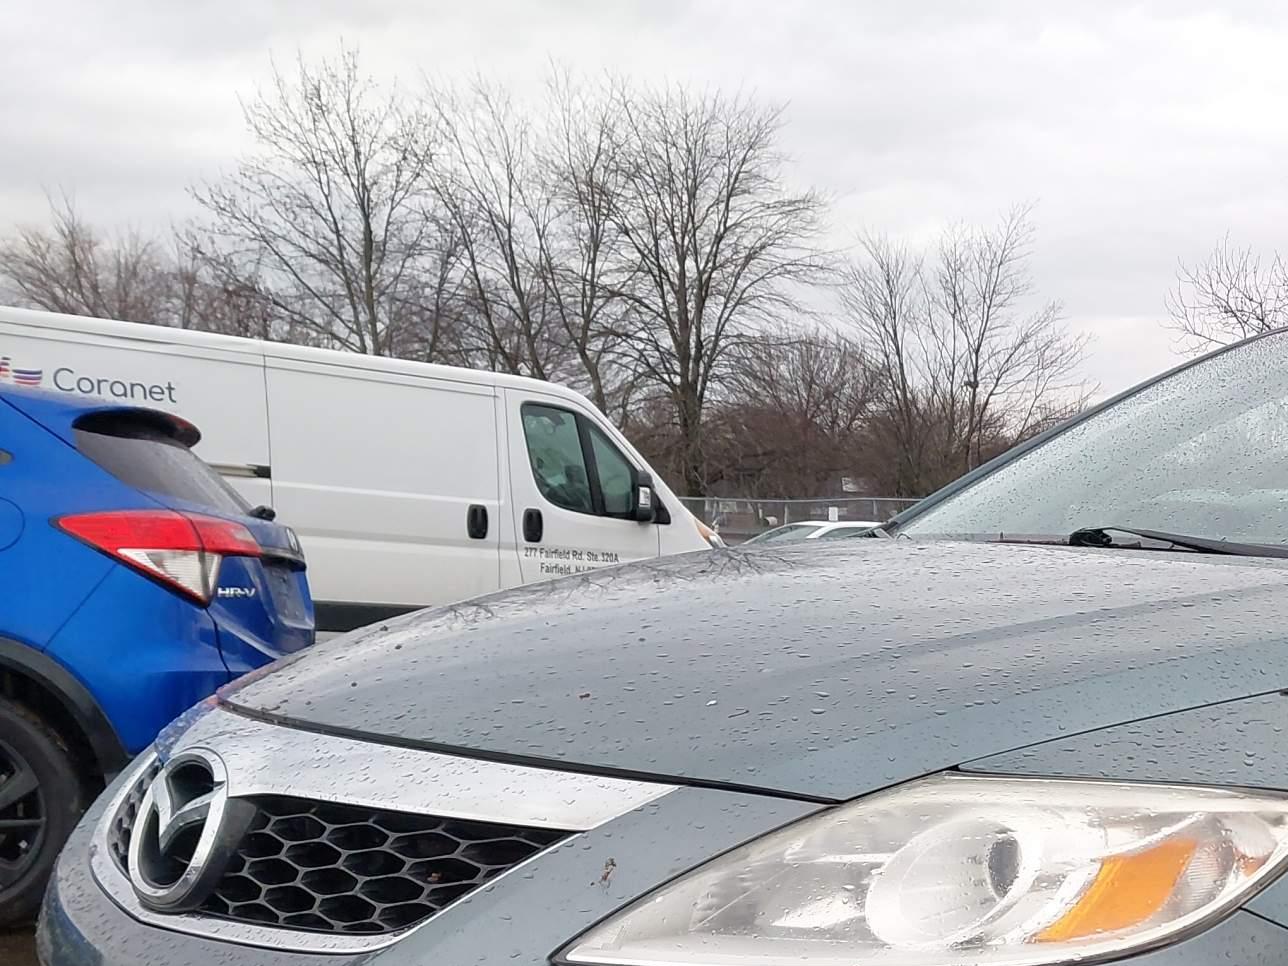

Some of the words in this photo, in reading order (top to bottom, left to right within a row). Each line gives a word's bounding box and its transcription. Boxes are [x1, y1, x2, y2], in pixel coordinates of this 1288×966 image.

[53, 367, 177, 404] Coranet
[524, 547, 538, 558] 277
[539, 548, 570, 560] Fairfield
[572, 550, 584, 561] Rd.
[217, 587, 256, 598] HR-V
